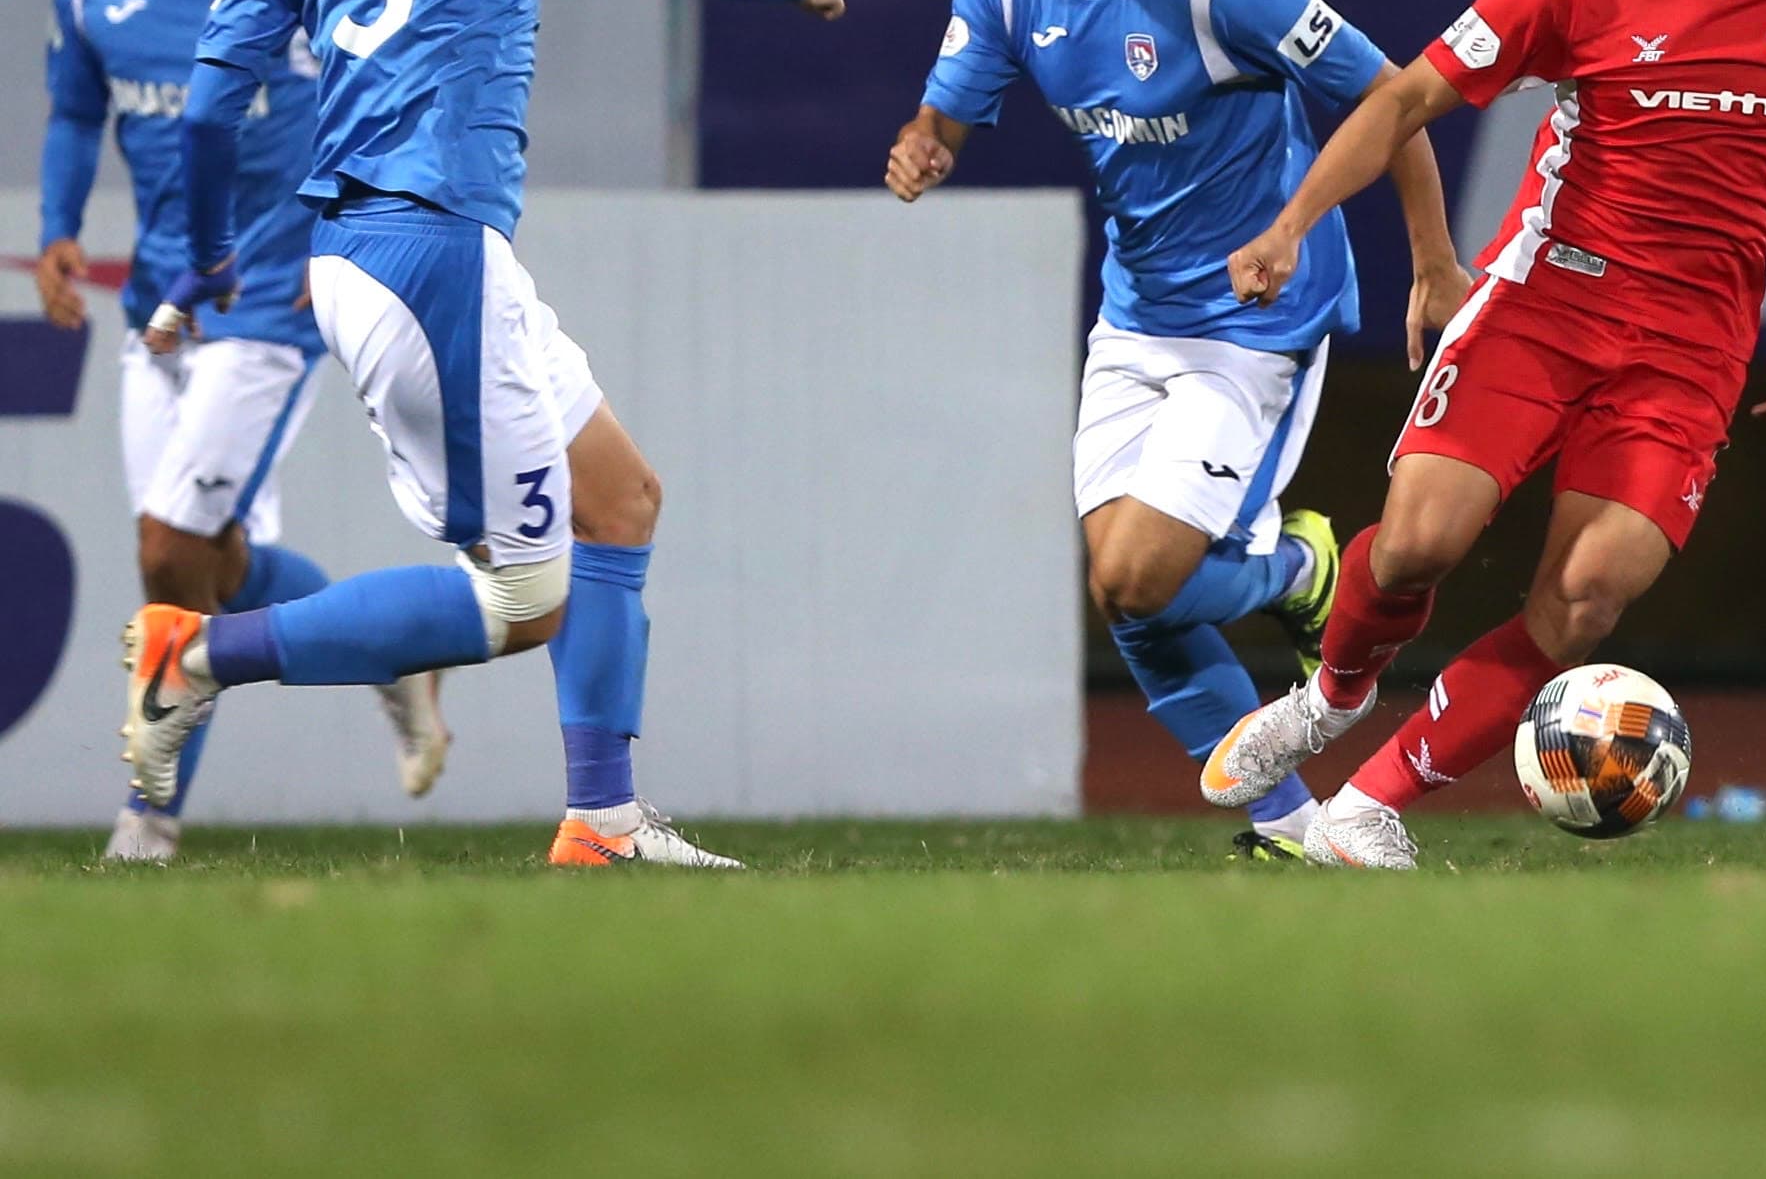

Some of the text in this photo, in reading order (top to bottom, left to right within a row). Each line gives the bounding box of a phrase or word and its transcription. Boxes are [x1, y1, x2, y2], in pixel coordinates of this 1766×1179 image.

[1295, 9, 1333, 58] LS
[1632, 50, 1665, 62] FBT
[1414, 364, 1459, 428] 8
[516, 466, 554, 539] 3
